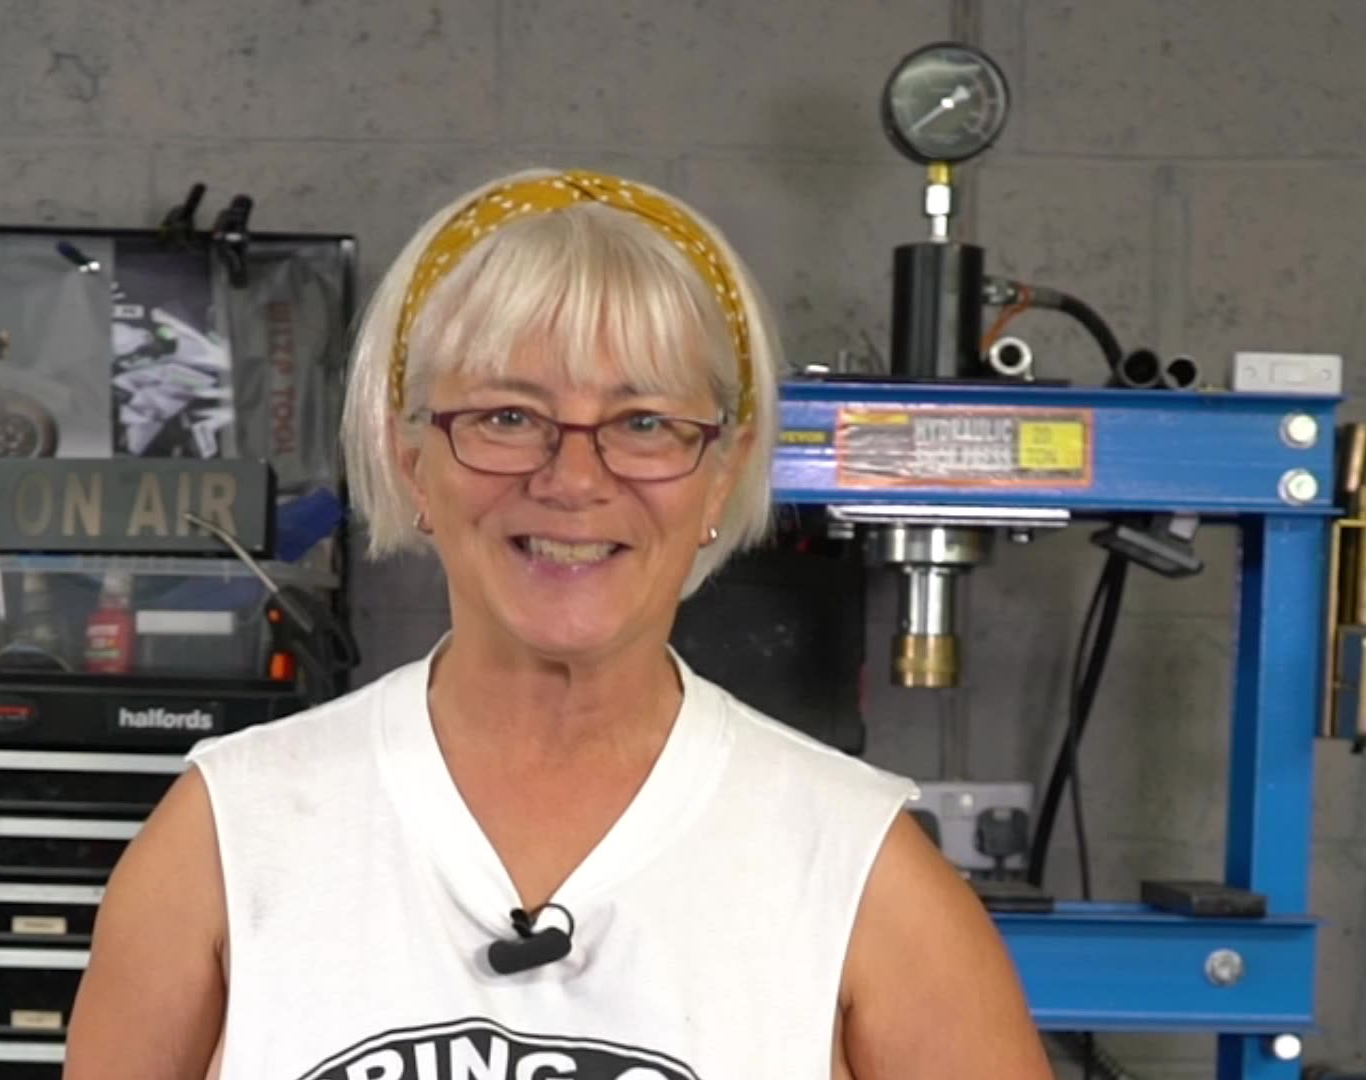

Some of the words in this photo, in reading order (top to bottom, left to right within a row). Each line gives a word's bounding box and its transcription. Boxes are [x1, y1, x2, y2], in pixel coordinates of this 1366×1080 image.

[14, 472, 102, 537] ON
[126, 472, 238, 537] AIR
[118, 707, 214, 730] halfords
